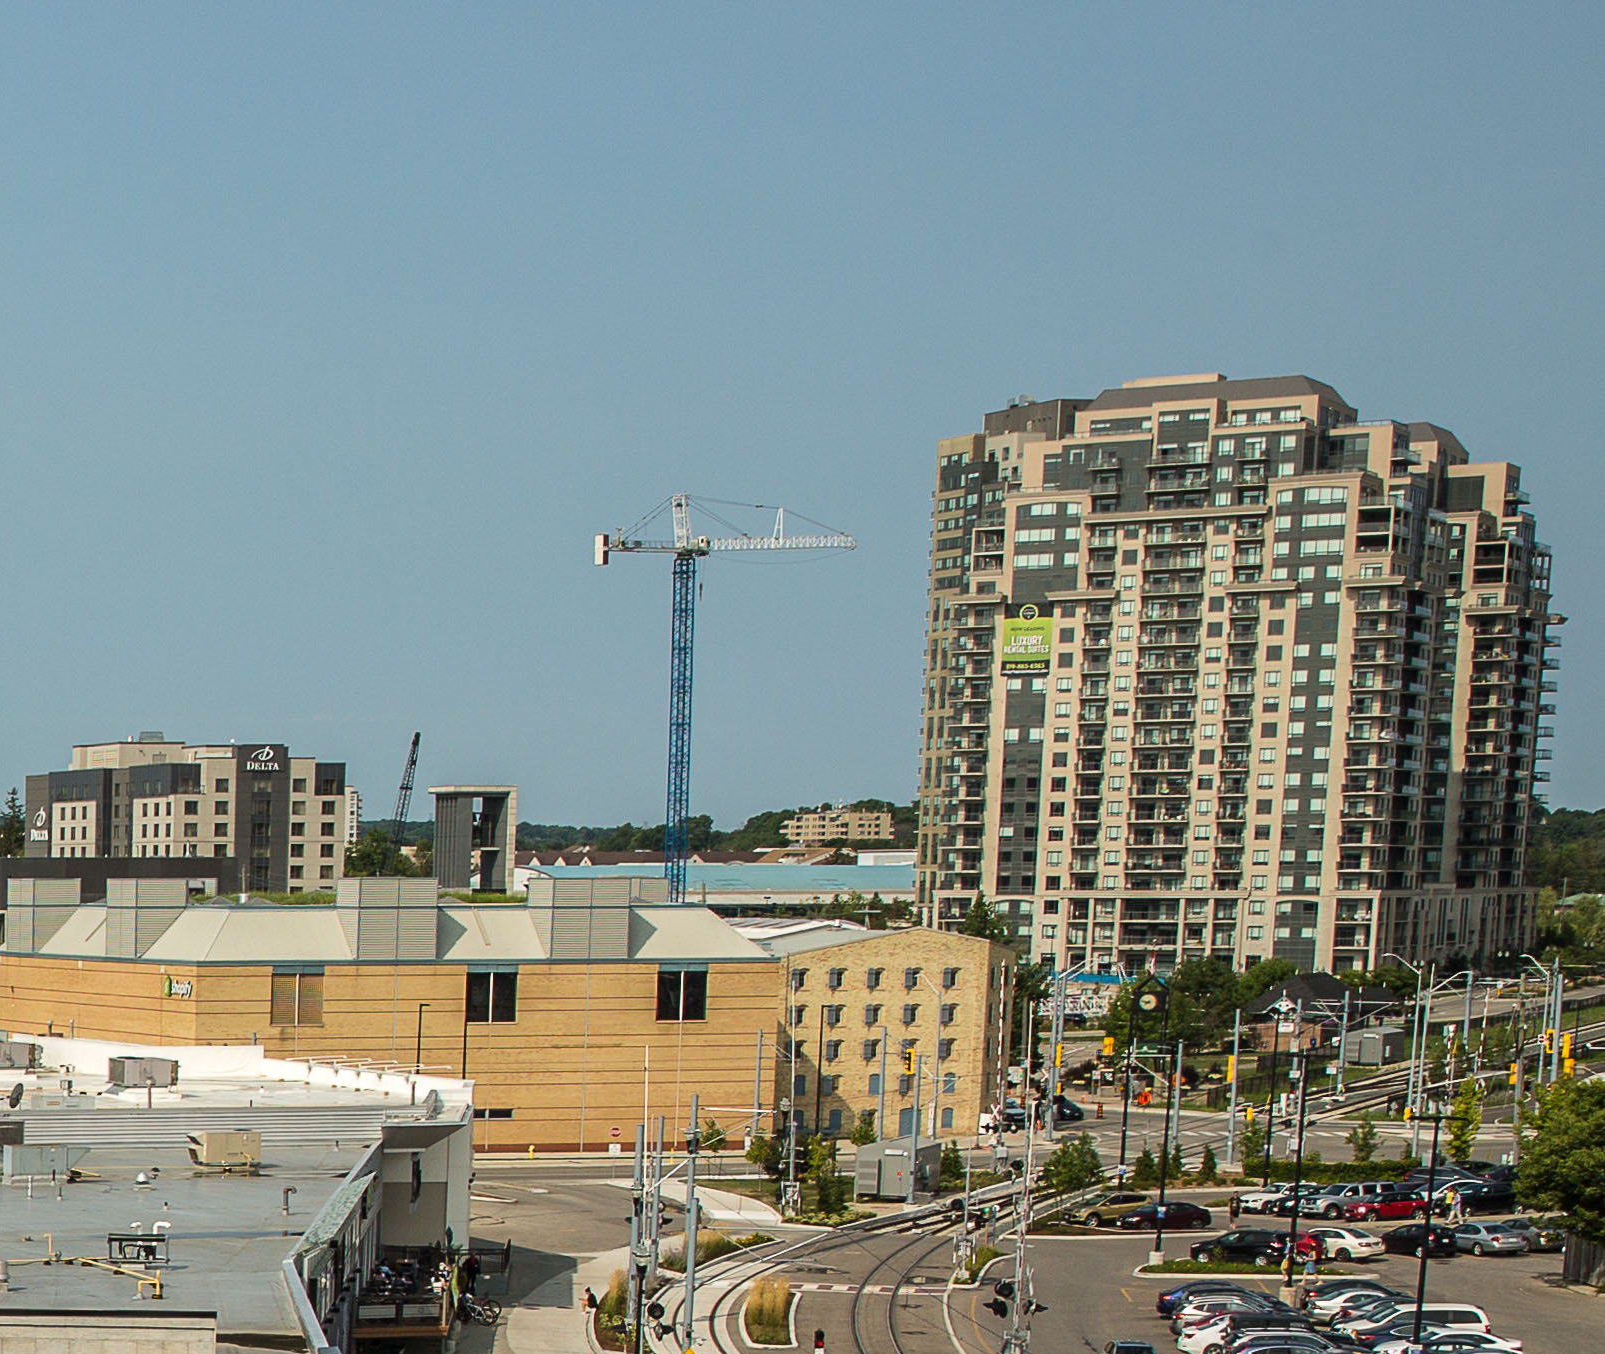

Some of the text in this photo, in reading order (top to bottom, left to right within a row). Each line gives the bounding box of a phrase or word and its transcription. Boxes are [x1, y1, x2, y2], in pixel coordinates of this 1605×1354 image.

[1011, 635, 1043, 646] LUXURY
[246, 760, 280, 771] DELTA
[171, 979, 193, 1000] shopify
